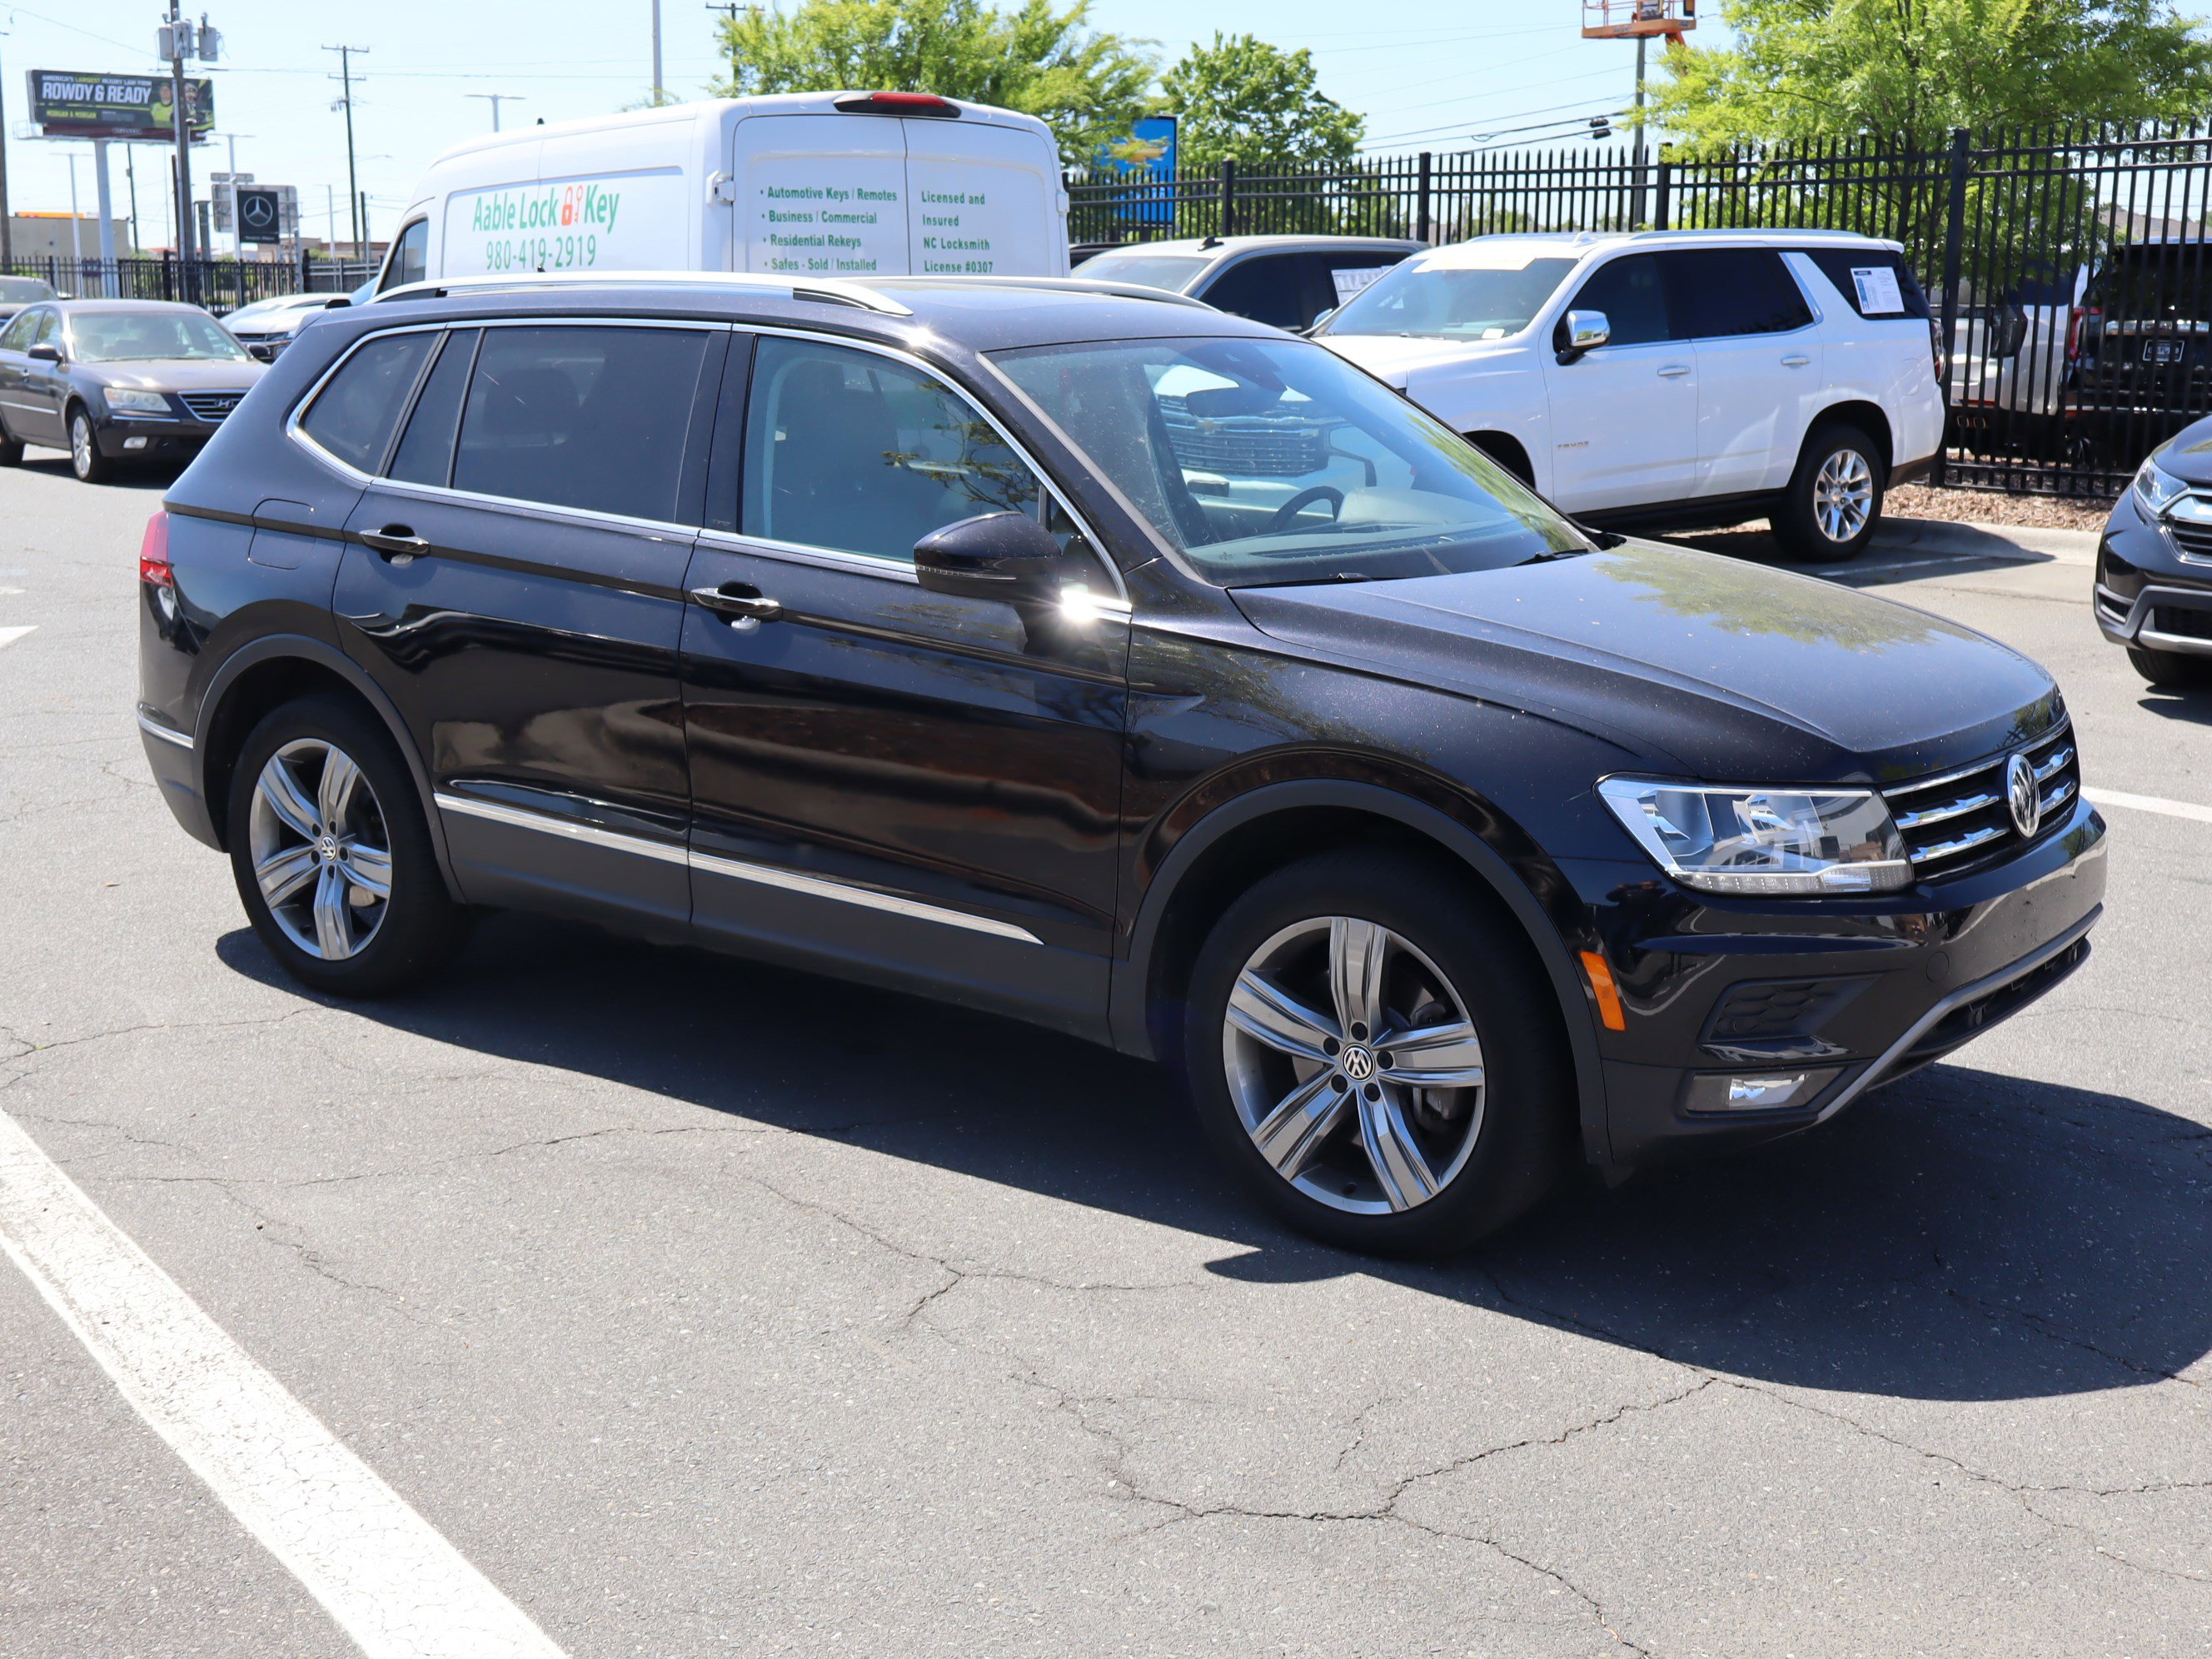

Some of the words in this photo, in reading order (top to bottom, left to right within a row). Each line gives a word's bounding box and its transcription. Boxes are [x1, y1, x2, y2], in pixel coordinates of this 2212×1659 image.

[42, 82, 93, 101] ROWDY
[95, 84, 105, 102] &
[107, 85, 152, 104] READY
[767, 186, 823, 199] Automotive
[825, 187, 849, 202] Keys
[857, 187, 898, 202] Remotes
[921, 191, 965, 204] Licensed
[969, 193, 985, 205] and
[472, 192, 516, 232] Aable
[520, 187, 559, 229] Lock
[585, 184, 620, 234] Key
[769, 210, 814, 222] Business
[821, 211, 877, 224] Commercial
[922, 213, 959, 227] Insured
[770, 233, 825, 247] Residential
[828, 234, 861, 250] Rekeys
[924, 237, 937, 249] NC
[940, 237, 990, 250] Locksmith
[486, 234, 596, 270] 980-419-2919
[771, 257, 800, 271] Safes
[808, 257, 829, 271] Sold
[836, 258, 877, 271] Installed
[924, 259, 962, 272] License
[965, 261, 994, 273] #0307
